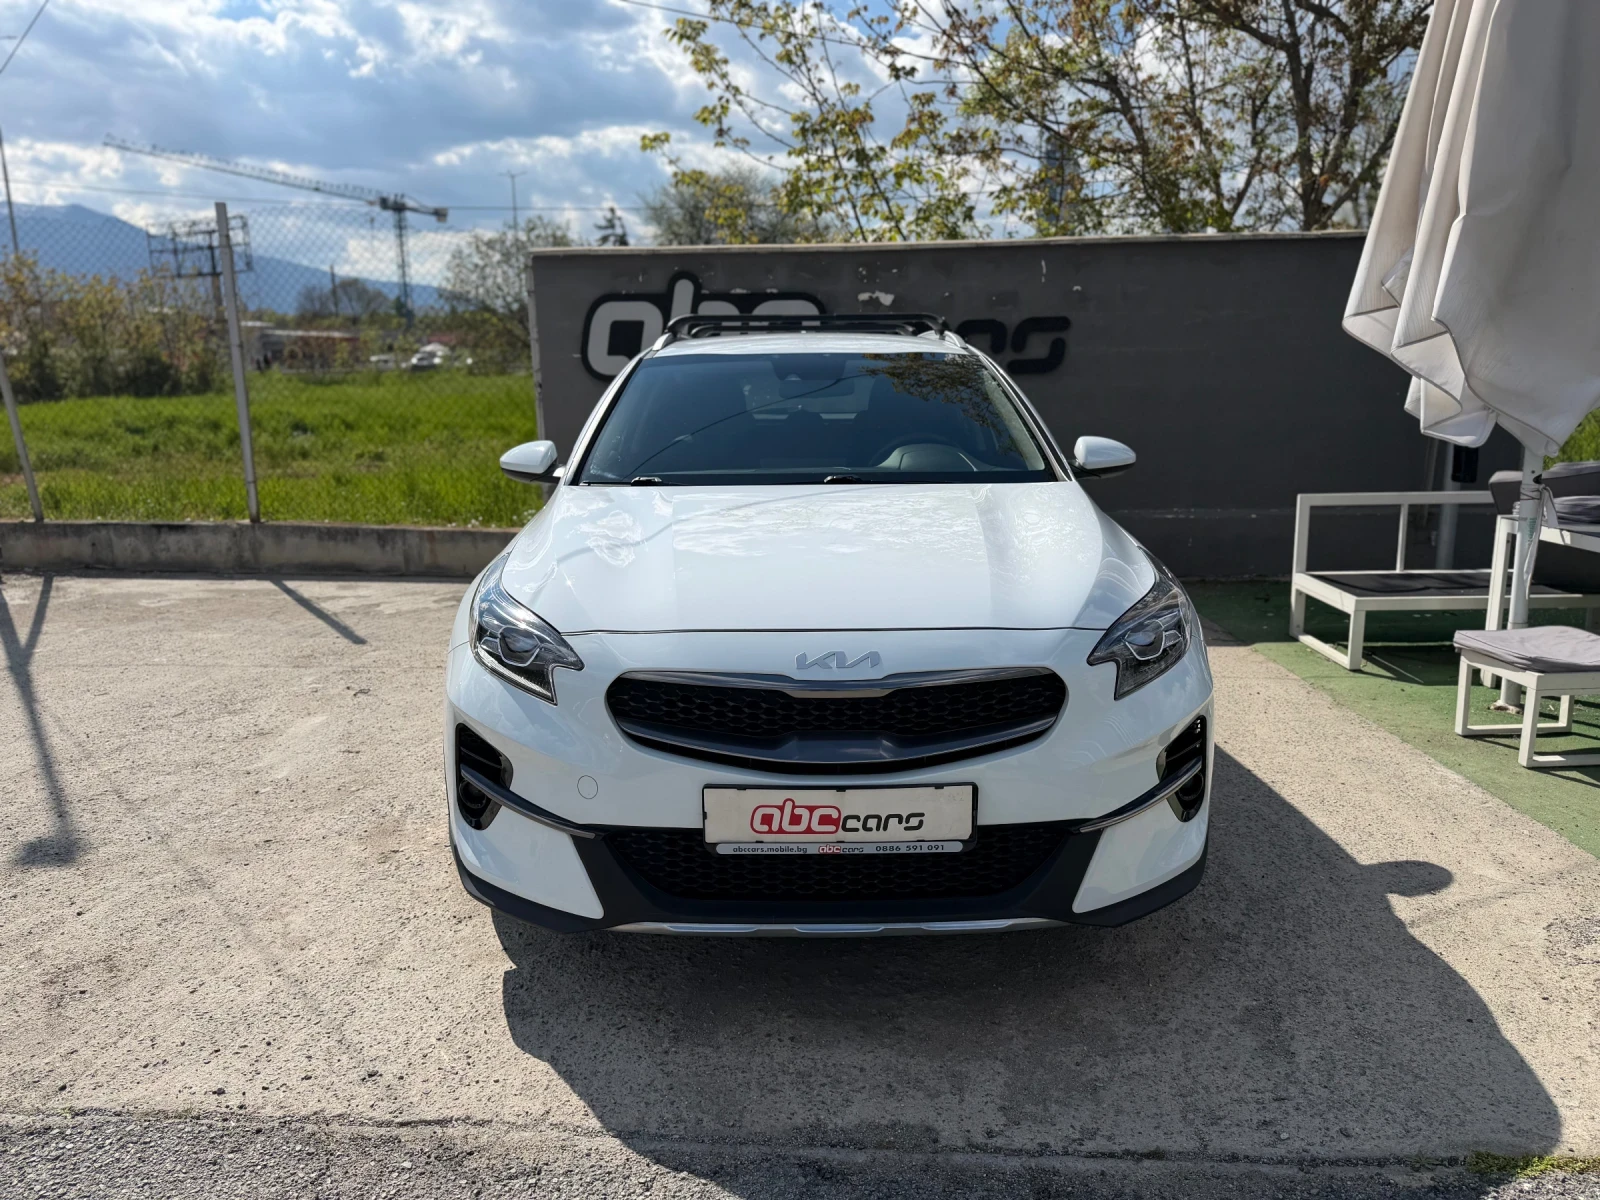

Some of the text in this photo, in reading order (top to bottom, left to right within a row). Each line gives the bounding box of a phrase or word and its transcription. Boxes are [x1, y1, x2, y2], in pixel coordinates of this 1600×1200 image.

[752, 799, 926, 833] abc cars
[732, 845, 808, 854] abccars.mobile.bg
[818, 844, 841, 854] abc
[905, 844, 923, 852] 591
